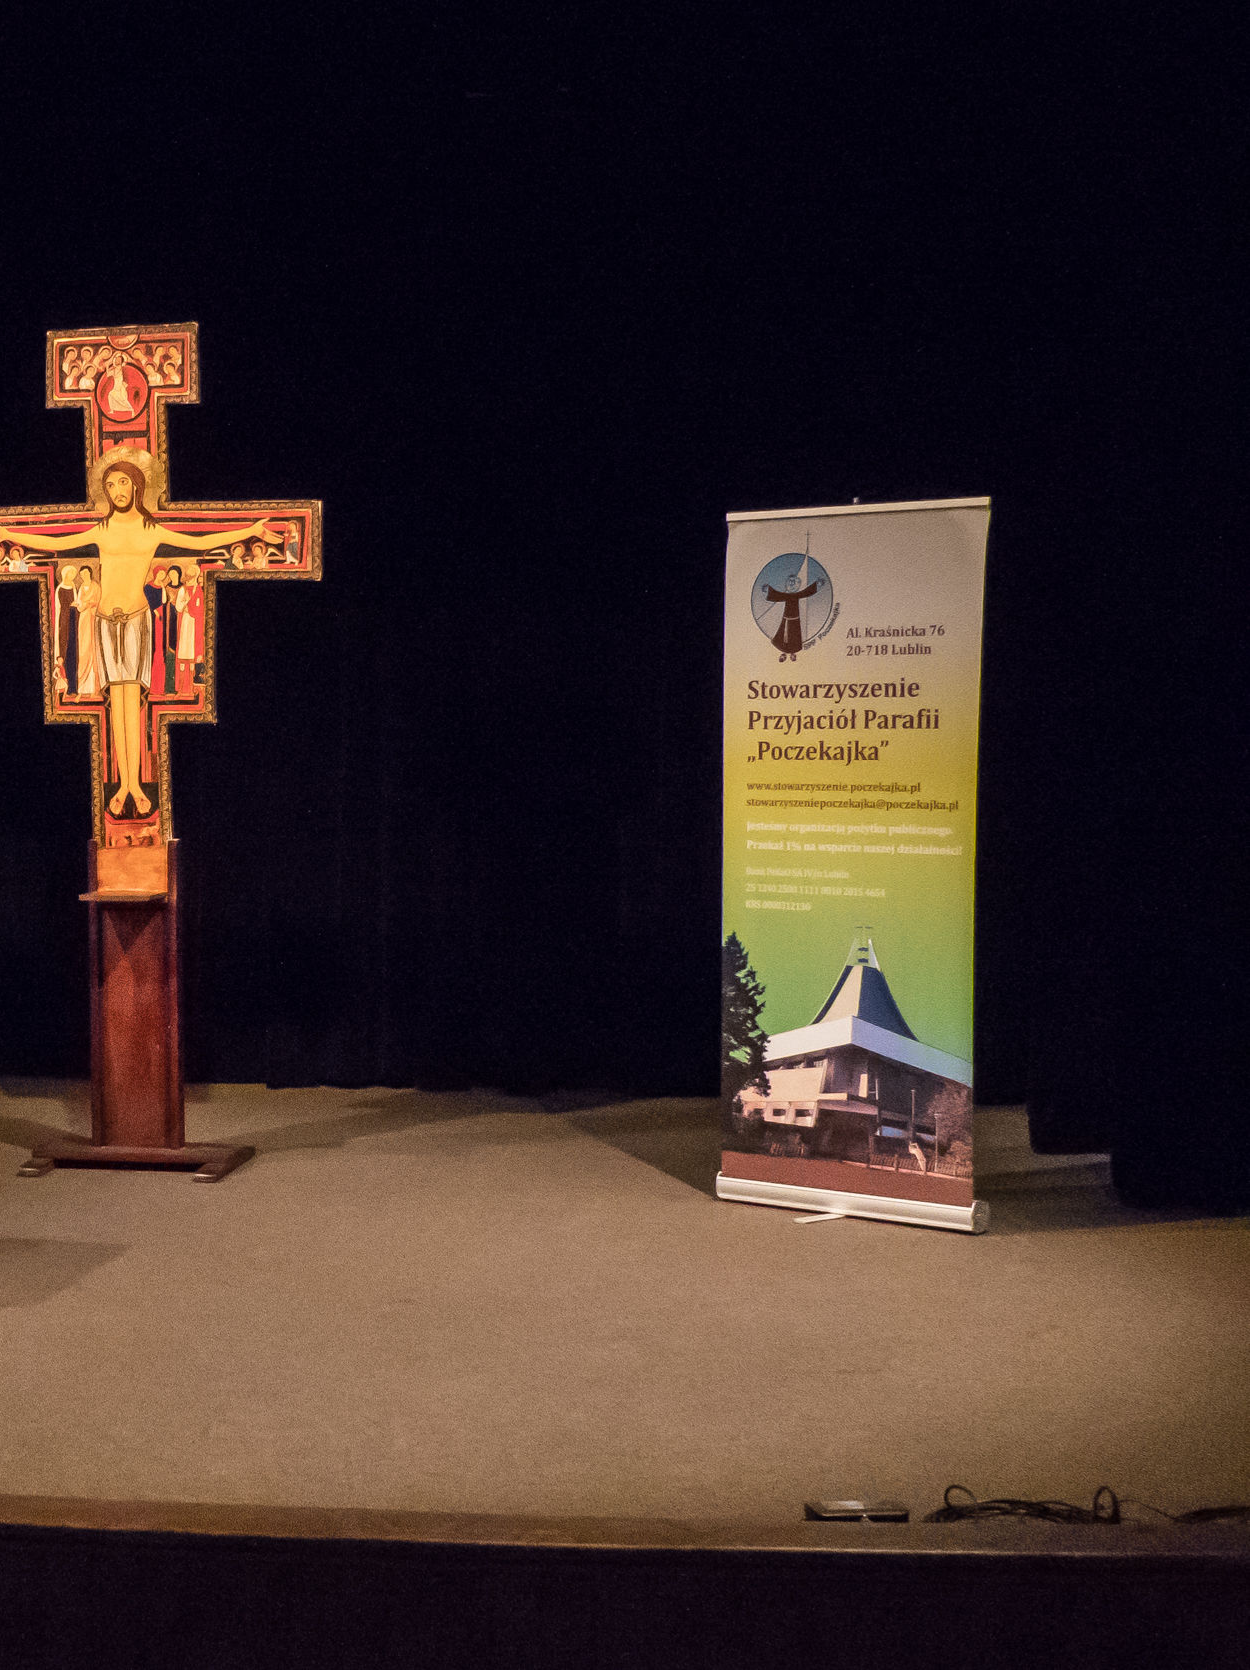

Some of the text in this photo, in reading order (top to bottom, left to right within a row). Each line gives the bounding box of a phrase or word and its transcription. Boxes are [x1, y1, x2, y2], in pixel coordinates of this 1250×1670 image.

[846, 624, 945, 639] Al. Kraśnicka 76
[846, 643, 932, 657] 20-718 Lublin
[747, 677, 920, 703] Stowarzyszenie
[747, 708, 940, 735] Przyjaciół Parafii
[747, 782, 921, 794] www.stowarzyszenie.poczekajka.pl
[746, 798, 959, 812] stowarzyszeniepoczekajka@poczekajka.pl
[803, 843, 817, 852] na
[818, 842, 862, 855] wsparcie
[863, 845, 895, 856] naszej
